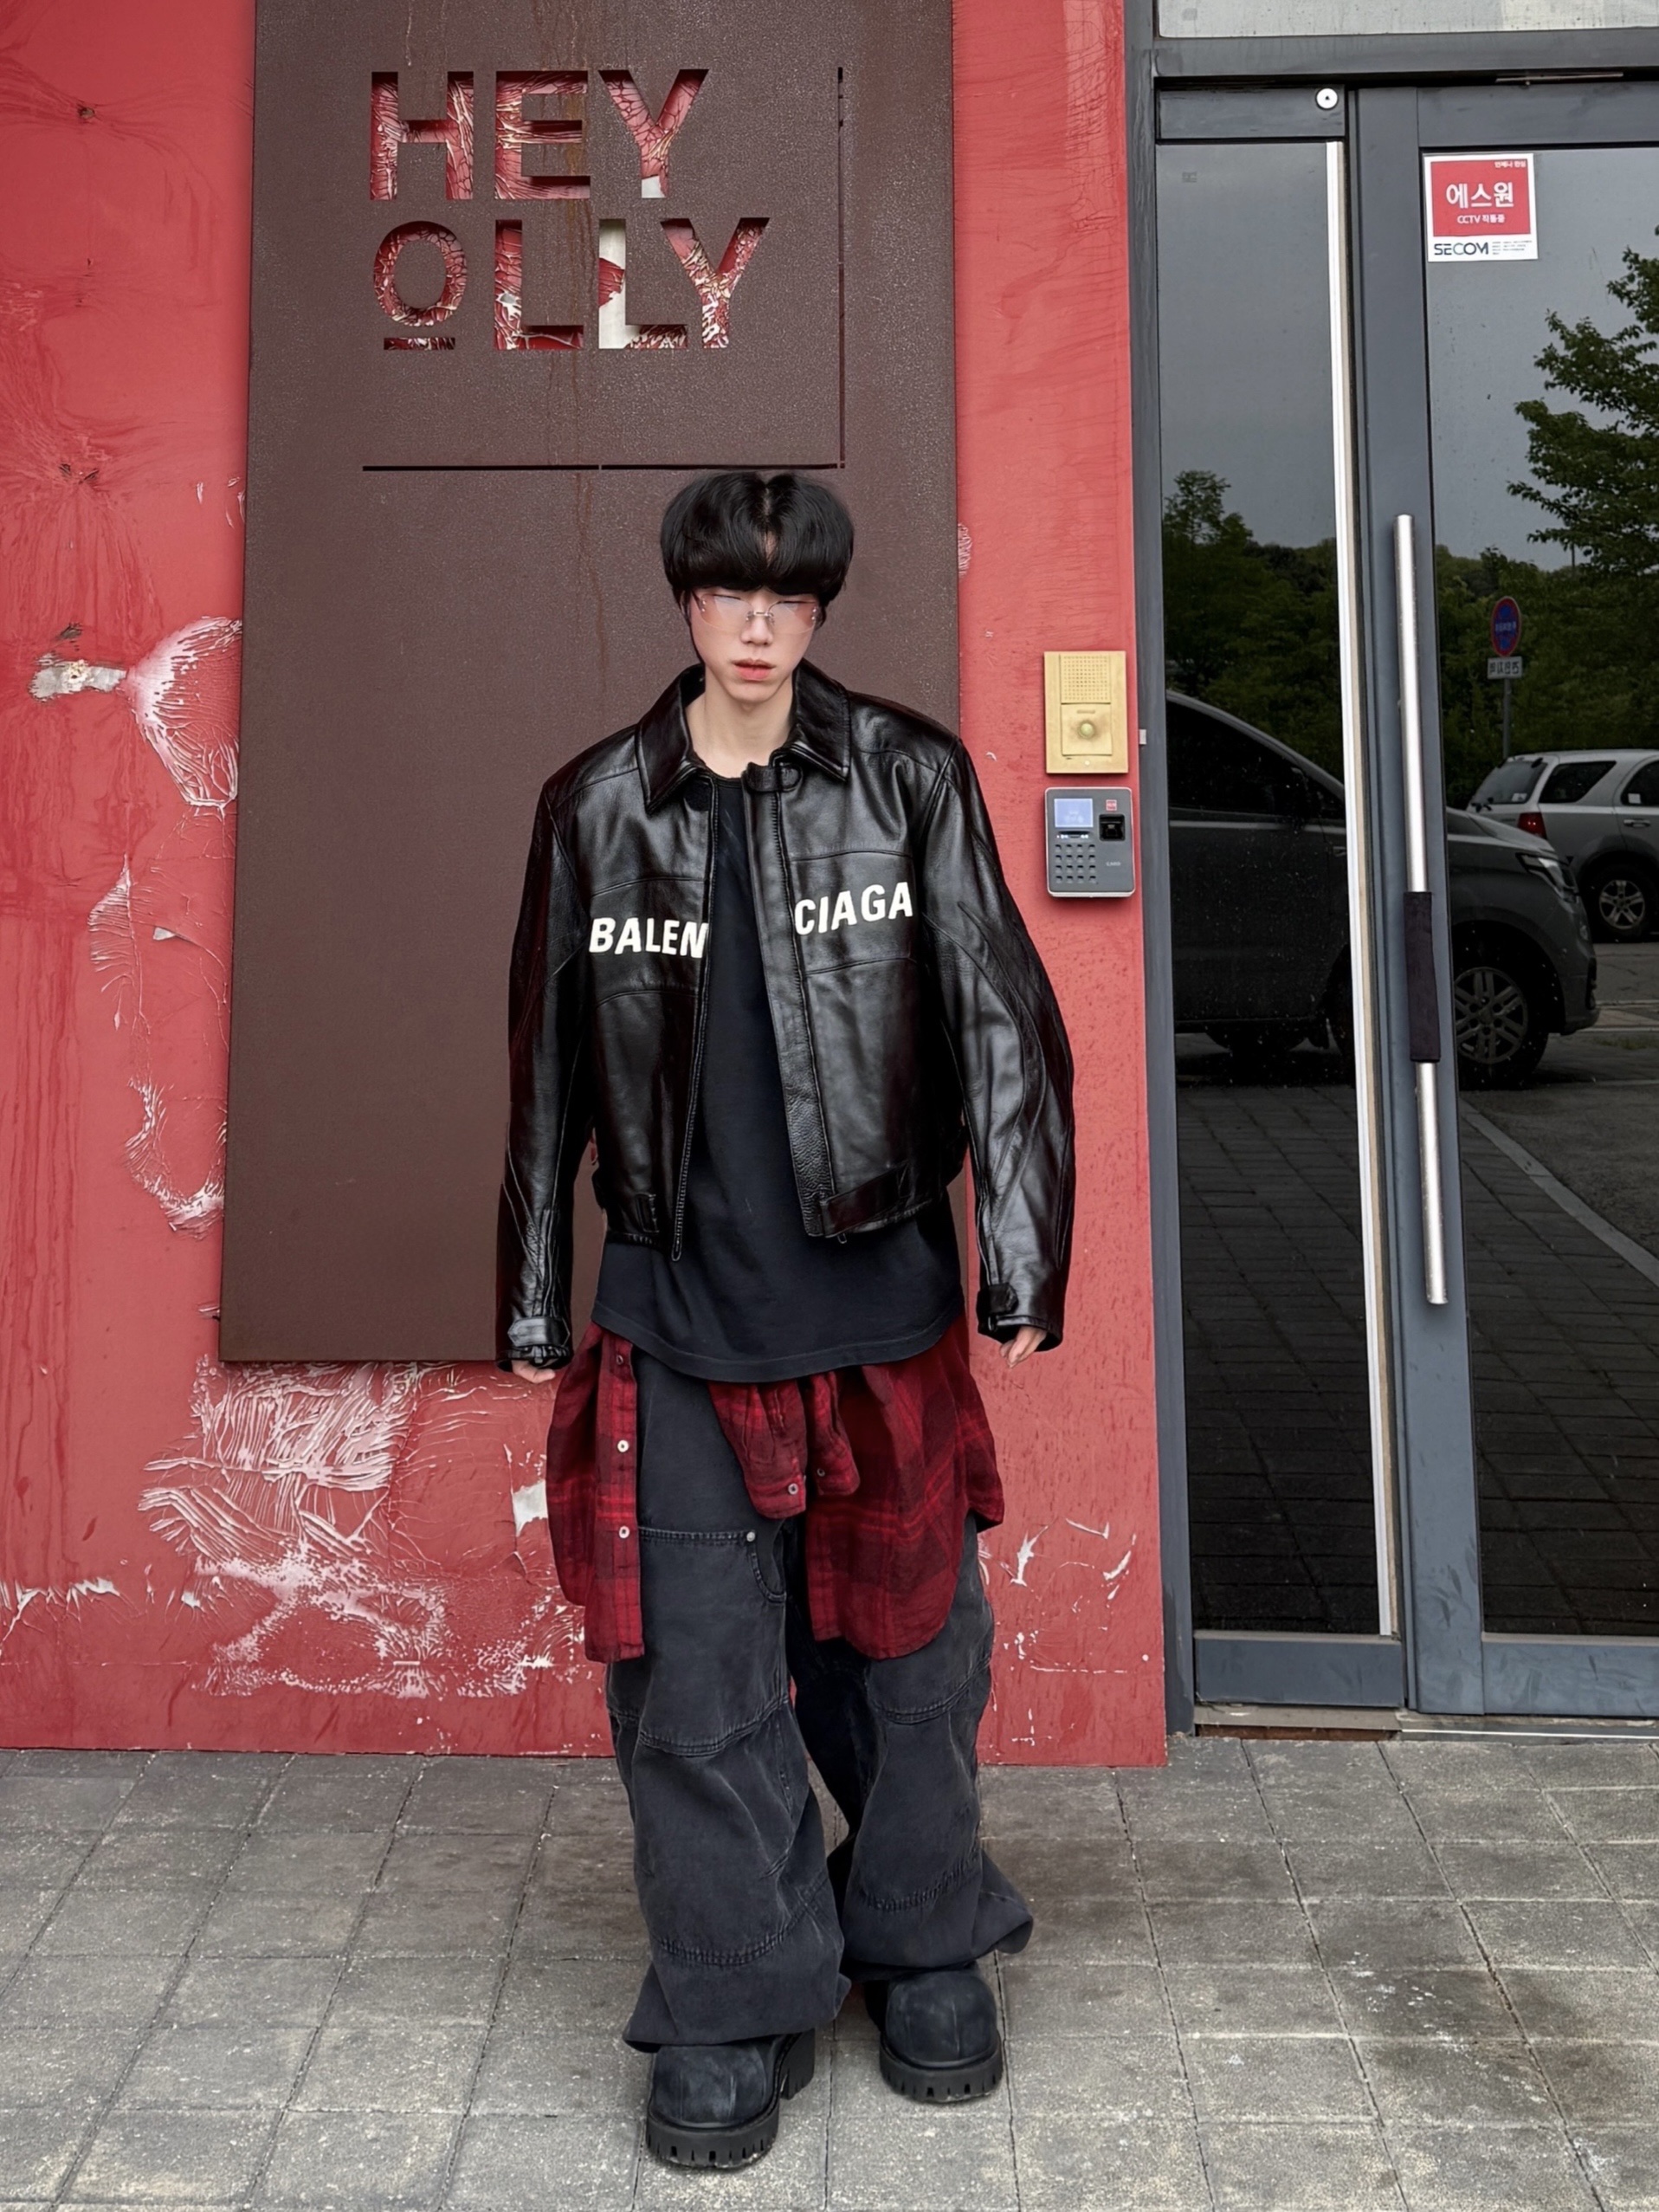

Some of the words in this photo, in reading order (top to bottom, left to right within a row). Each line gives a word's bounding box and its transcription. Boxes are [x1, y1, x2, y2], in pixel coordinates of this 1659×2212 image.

[370, 69, 709, 200] HEY
[1446, 182, 1514, 209] 에스원
[1457, 215, 1481, 223] CCTV
[1434, 242, 1489, 255] SECOM
[373, 217, 771, 350] OLLY
[589, 917, 709, 959] BALEN
[794, 882, 913, 935] CIAGA
